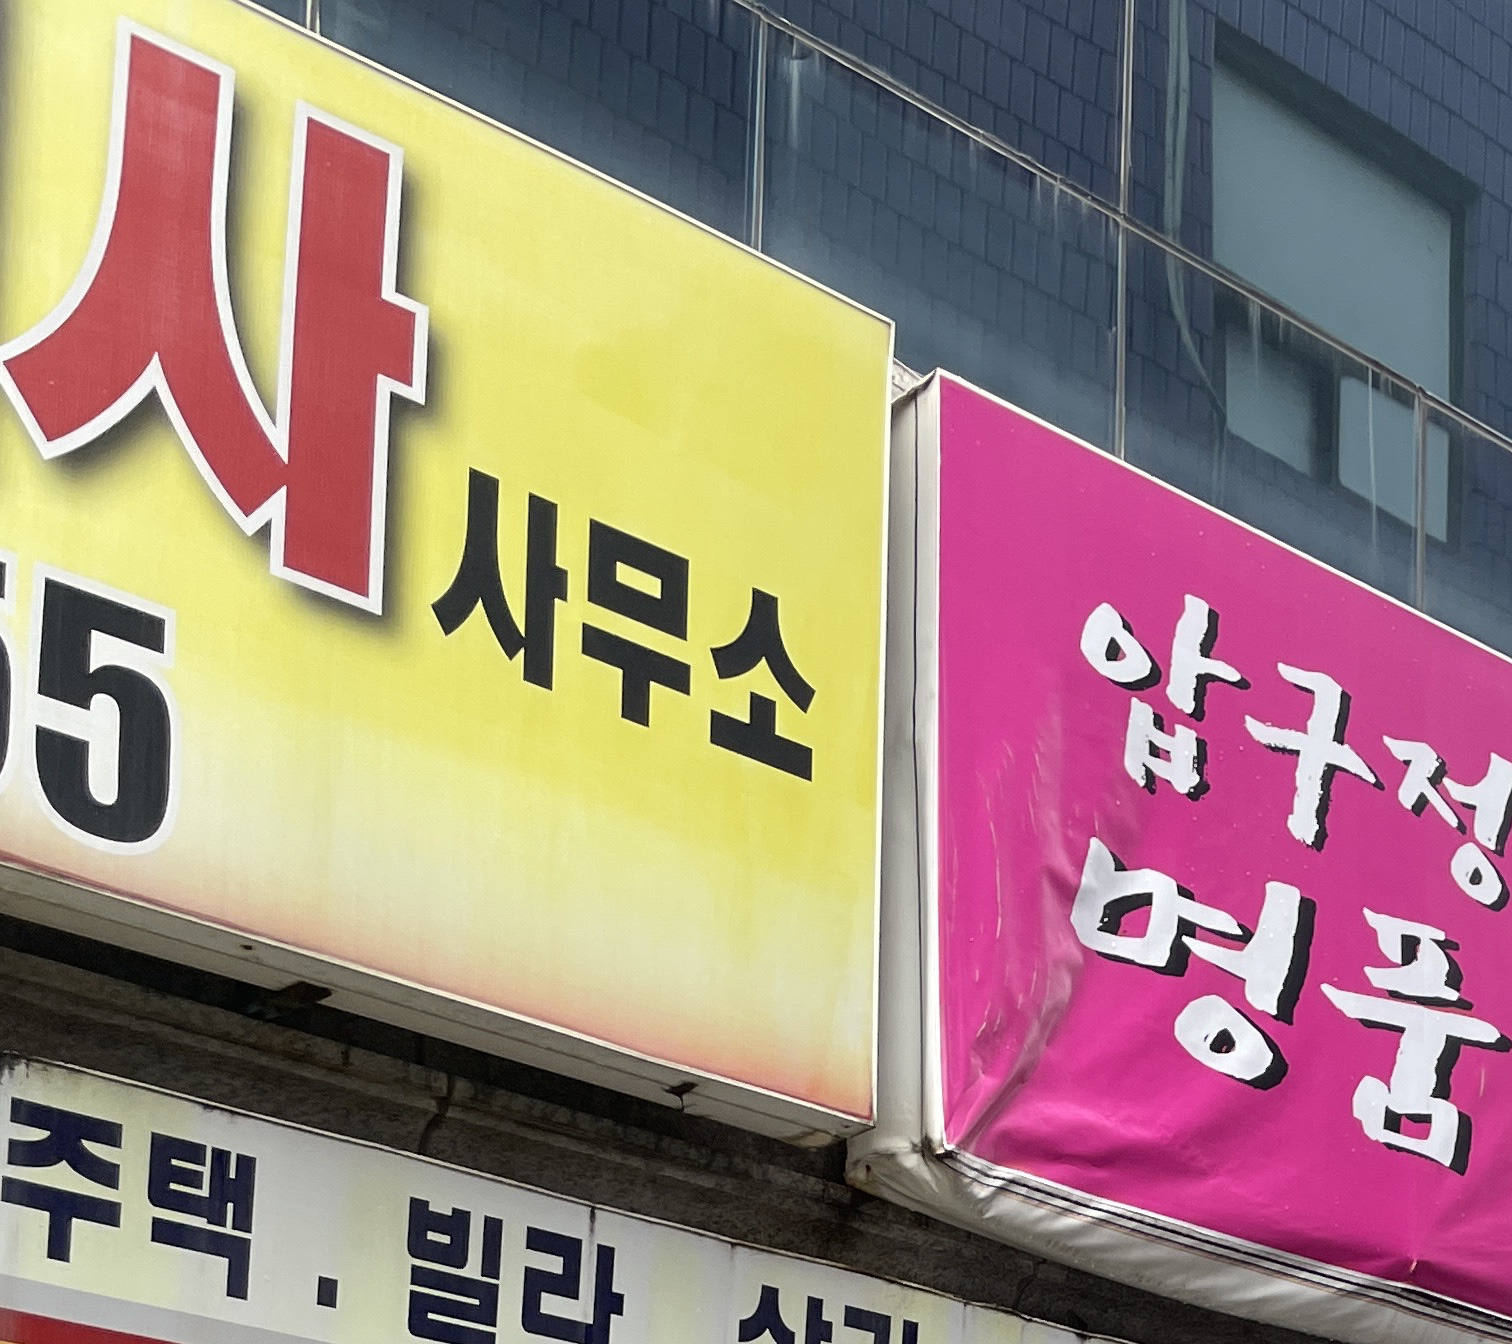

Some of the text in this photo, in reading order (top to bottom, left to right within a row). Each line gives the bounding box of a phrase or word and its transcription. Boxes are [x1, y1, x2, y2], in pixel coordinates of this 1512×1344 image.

[1, 20, 816, 782] 사 사무소
[0, 1096, 257, 1301] 주택
